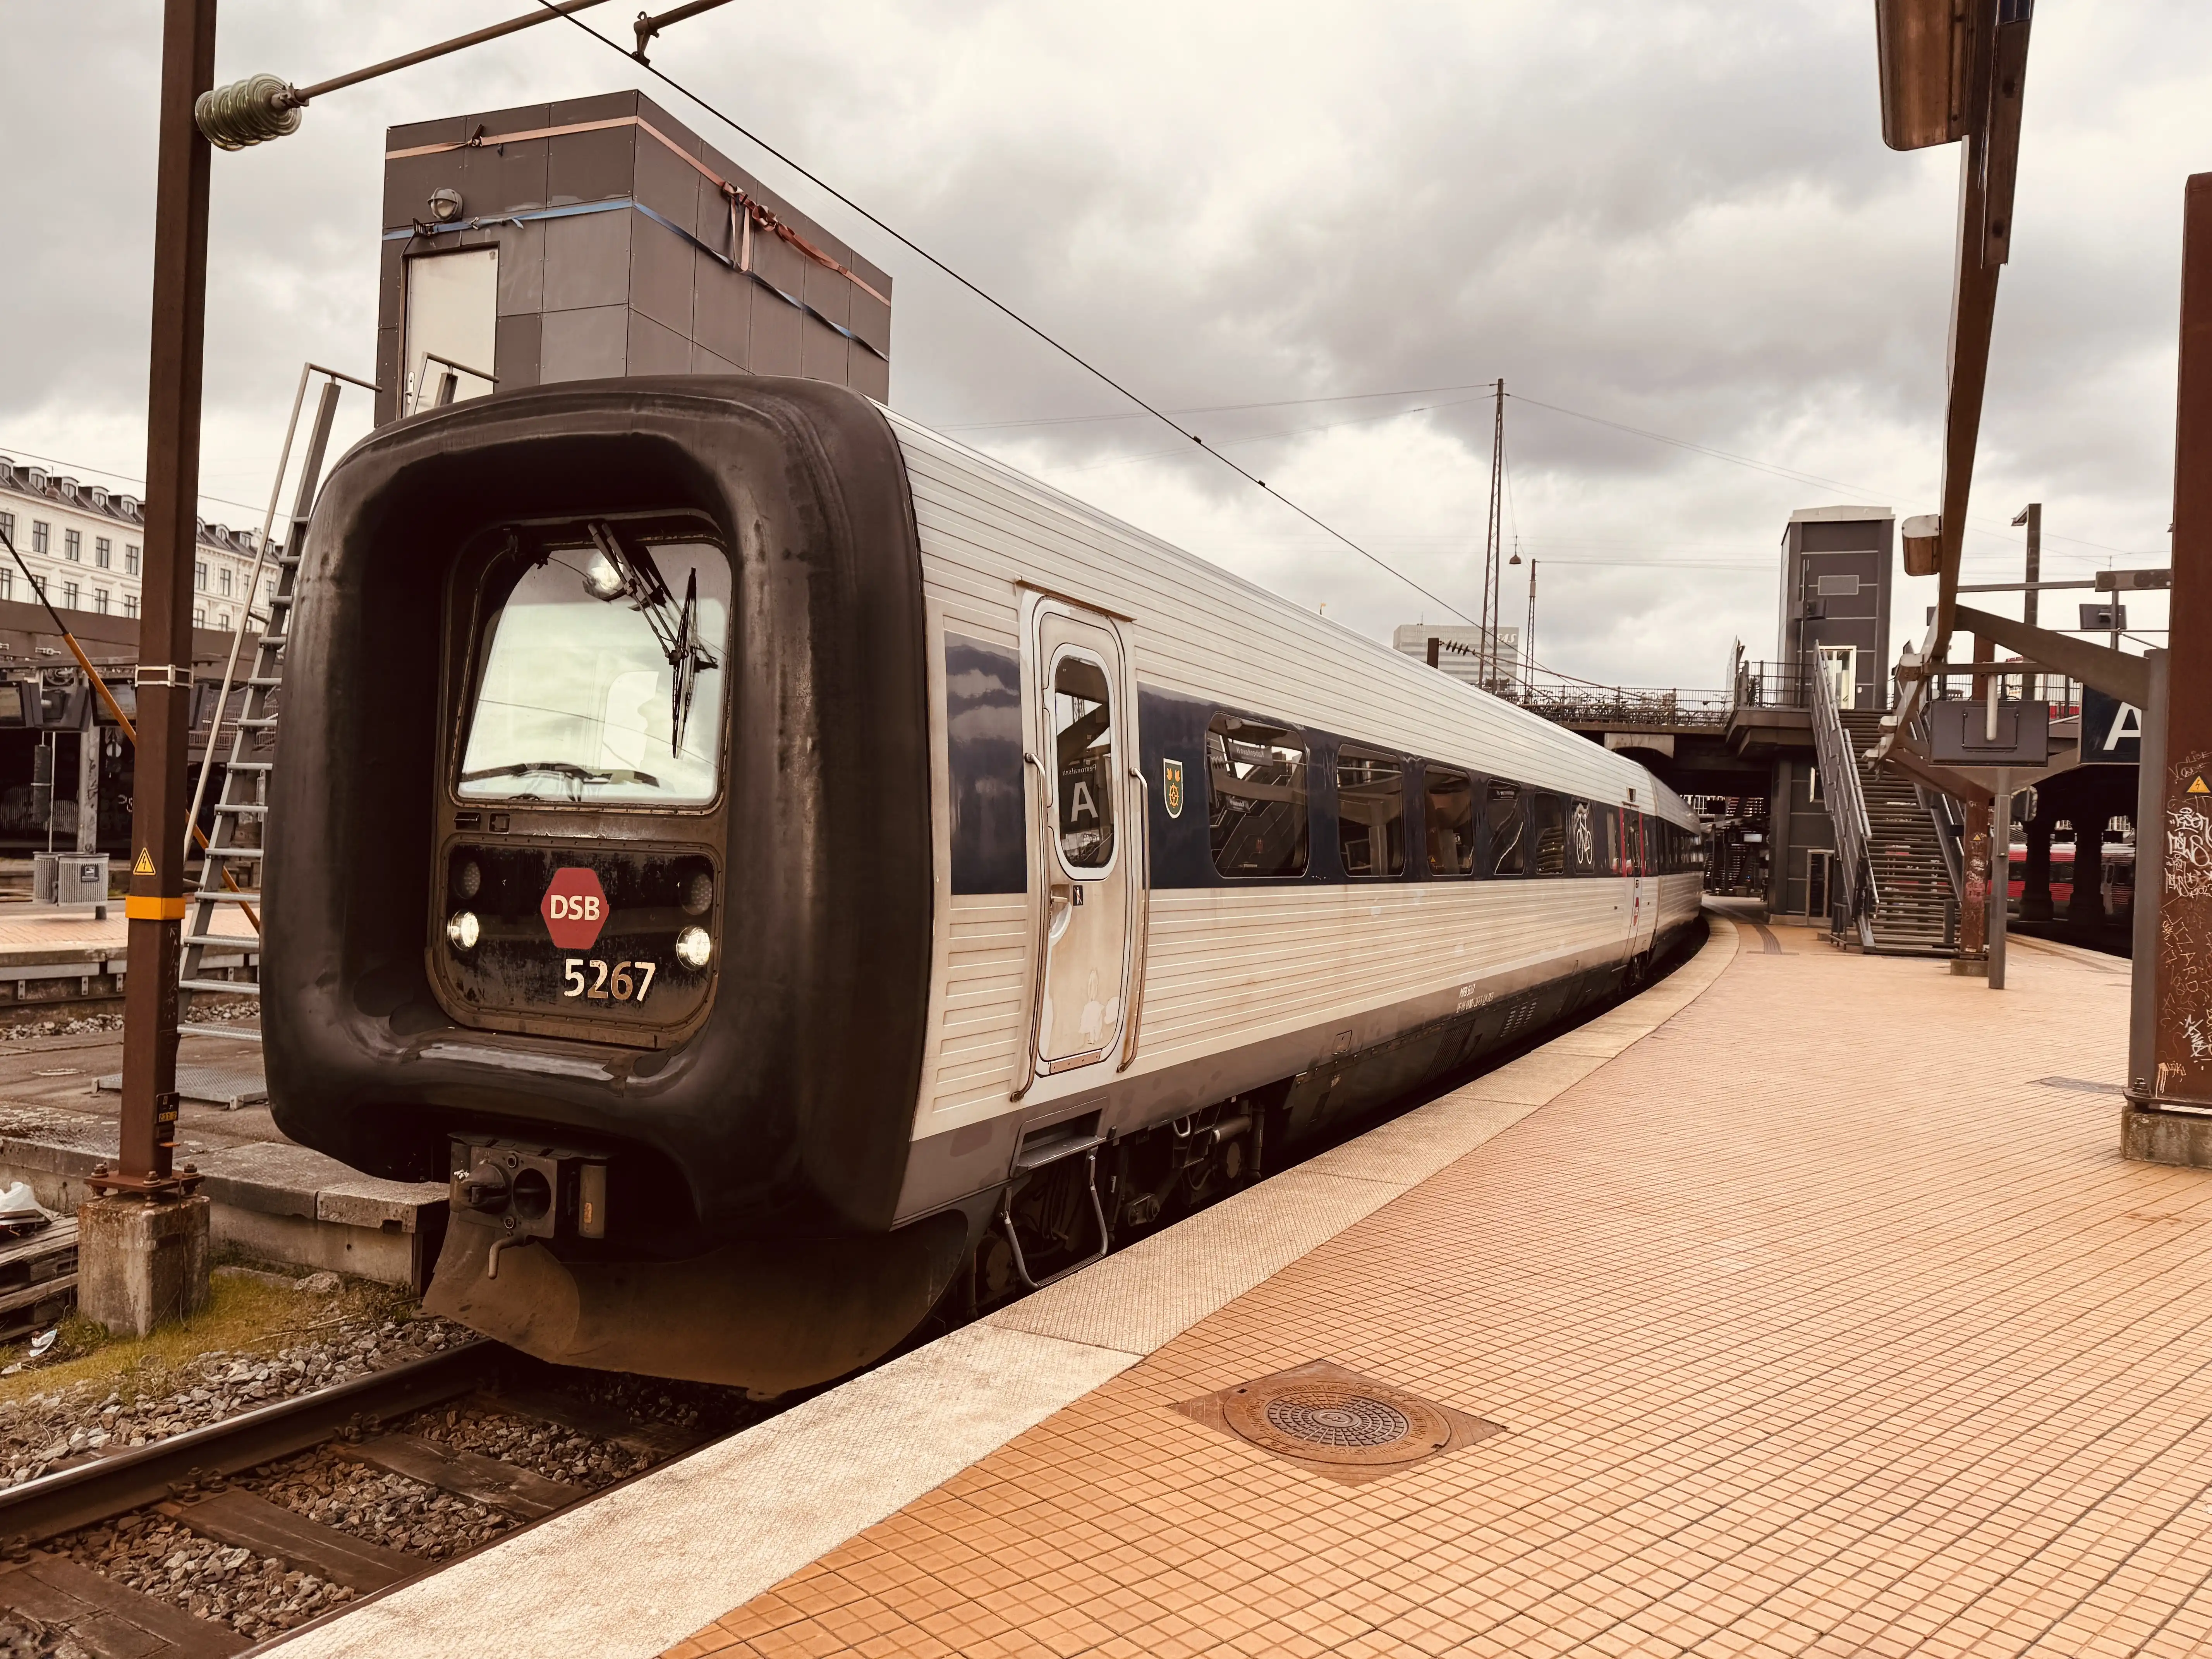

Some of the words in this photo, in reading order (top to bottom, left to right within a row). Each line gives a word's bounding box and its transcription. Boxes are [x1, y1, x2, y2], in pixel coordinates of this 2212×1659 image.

[1497, 633, 1517, 643] SAS
[2102, 701, 2141, 750] A
[550, 895, 600, 921] DSB
[564, 958, 656, 1002] 5267
